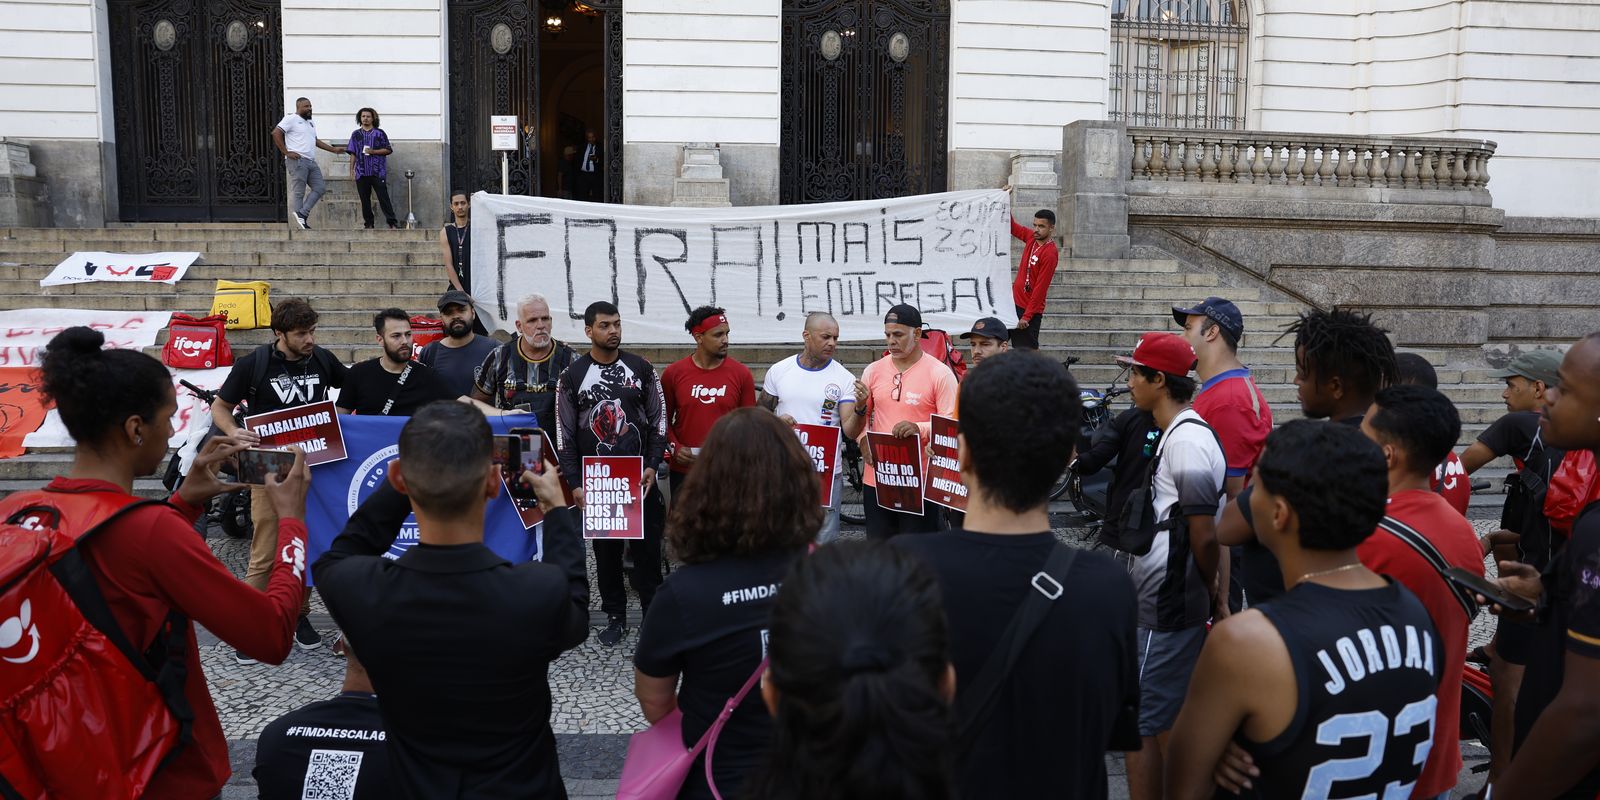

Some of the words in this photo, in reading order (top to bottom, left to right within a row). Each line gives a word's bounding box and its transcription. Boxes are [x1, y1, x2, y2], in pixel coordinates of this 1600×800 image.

[496, 213, 787, 321] FORA!
[799, 271, 998, 317] ENTREGA!
[174, 337, 213, 351] ifood
[691, 384, 727, 398] ifood
[253, 411, 332, 437] TRABALHADOR
[585, 462, 611, 477] NÃO
[877, 461, 898, 475] ALÉM
[900, 464, 914, 476] DO
[367, 468, 383, 488] RIO
[585, 477, 630, 491] SOMOS
[876, 471, 919, 488] TRABALHO
[932, 477, 968, 497] DIREITOS?
[585, 490, 637, 504] OBRIGA-
[586, 504, 611, 518] DOS
[615, 504, 625, 517] A
[586, 517, 628, 531] SUBIR!
[722, 583, 782, 606] #FIMDA
[286, 726, 386, 741] #FIMDAESCALA6
[1301, 694, 1438, 800] 23
